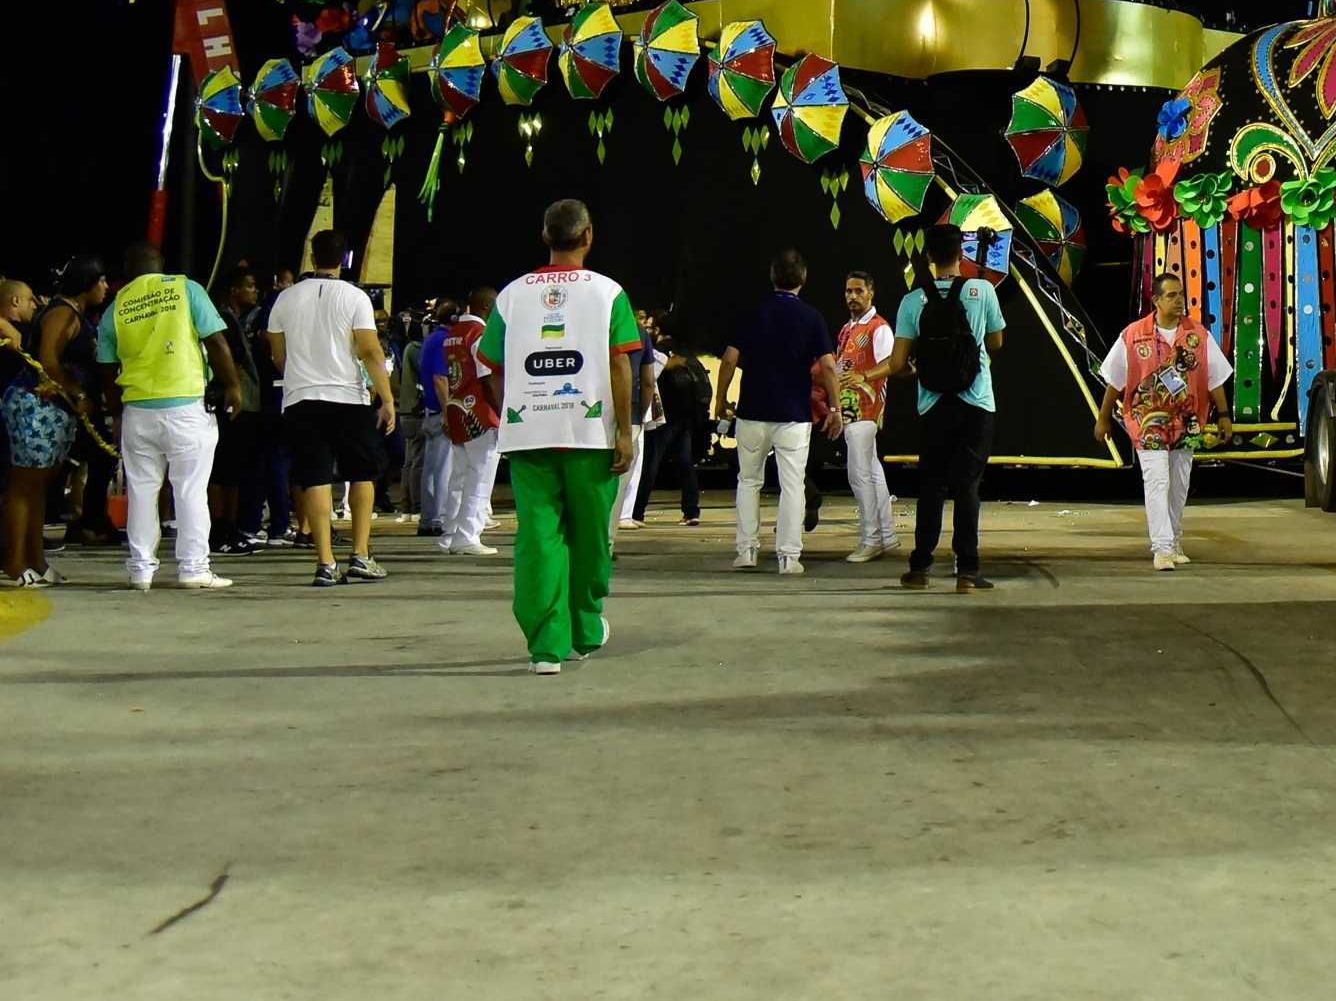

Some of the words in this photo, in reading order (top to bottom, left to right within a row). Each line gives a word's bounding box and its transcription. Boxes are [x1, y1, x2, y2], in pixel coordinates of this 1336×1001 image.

[526, 272, 579, 285] CARRO
[584, 274, 591, 282] 3
[118, 294, 180, 316] CONCENTRAÇÃO
[123, 290, 162, 308] COMISSÃO
[124, 309, 158, 325] CARNAVAL
[161, 305, 176, 313] 2018
[533, 358, 576, 369] UBER
[533, 403, 560, 411] CARNAVAL
